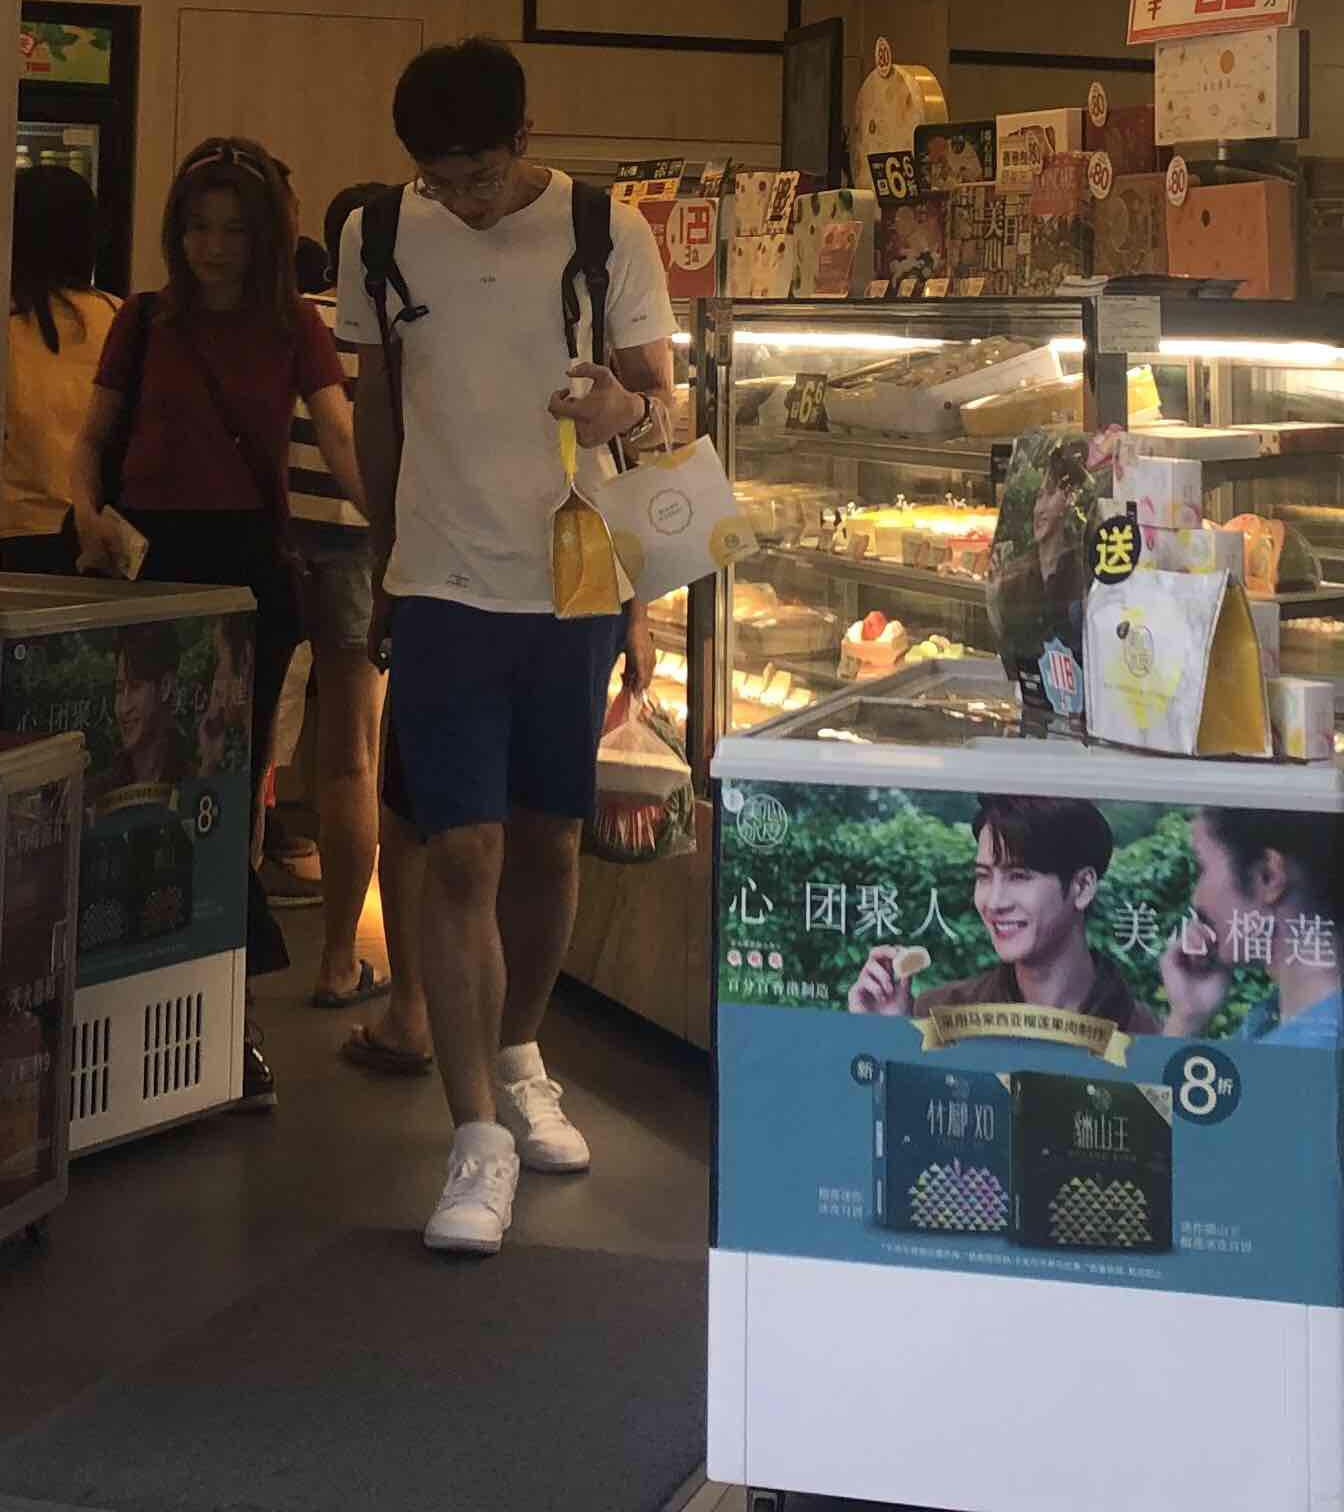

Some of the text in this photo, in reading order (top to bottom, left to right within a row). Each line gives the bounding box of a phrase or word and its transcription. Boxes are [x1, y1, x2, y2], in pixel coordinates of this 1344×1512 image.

[1094, 523, 1134, 575] 送
[727, 877, 1339, 971] 心 团聚人 美心榴莲
[1177, 1053, 1218, 1117] 8
